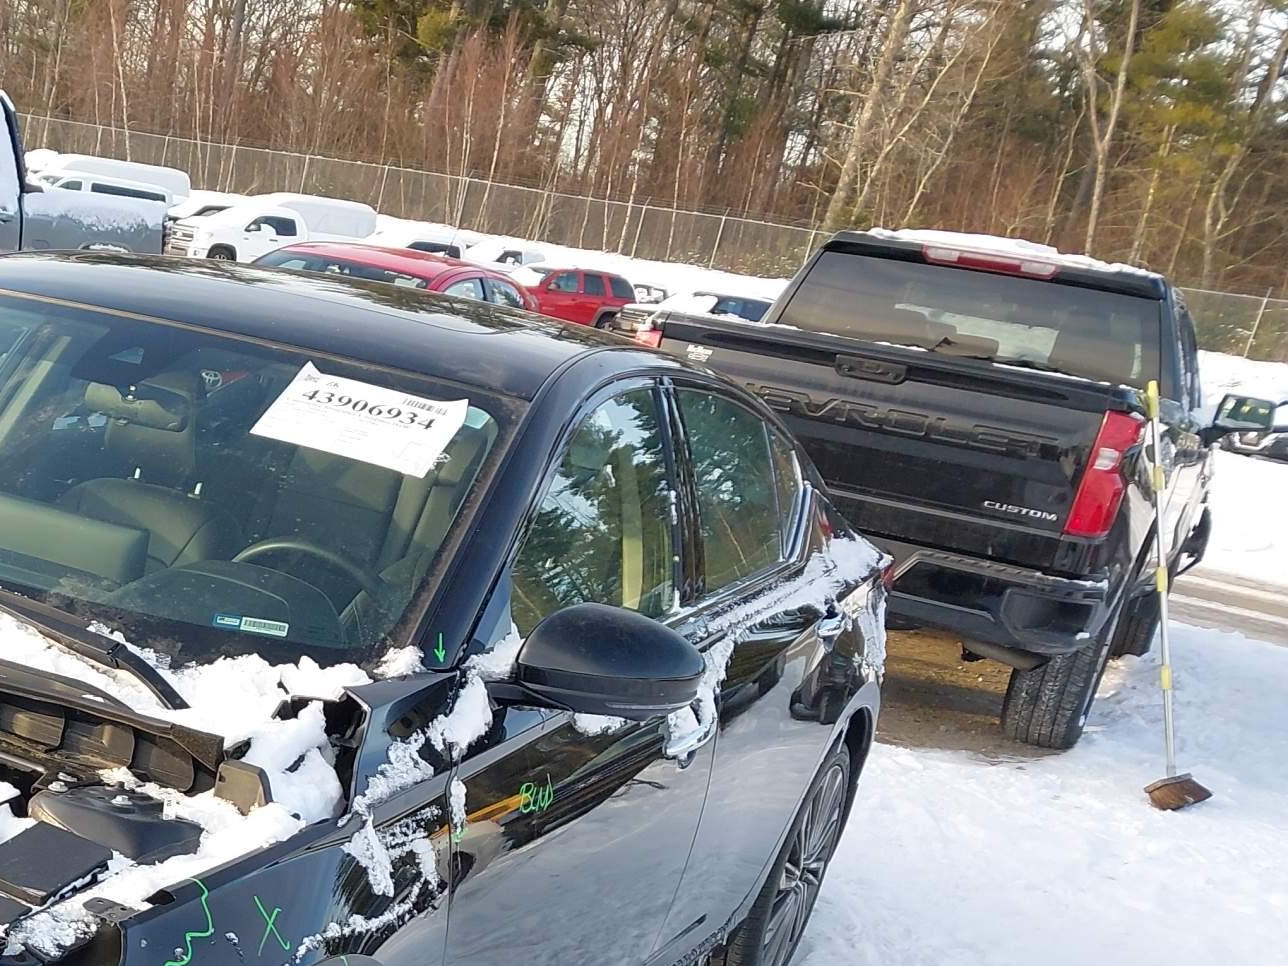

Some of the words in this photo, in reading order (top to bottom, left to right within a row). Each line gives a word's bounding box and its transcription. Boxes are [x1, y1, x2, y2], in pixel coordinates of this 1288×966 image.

[301, 389, 436, 430] 43906934
[746, 382, 1060, 458] EVROLET
[983, 500, 1058, 521] CUSTOM
